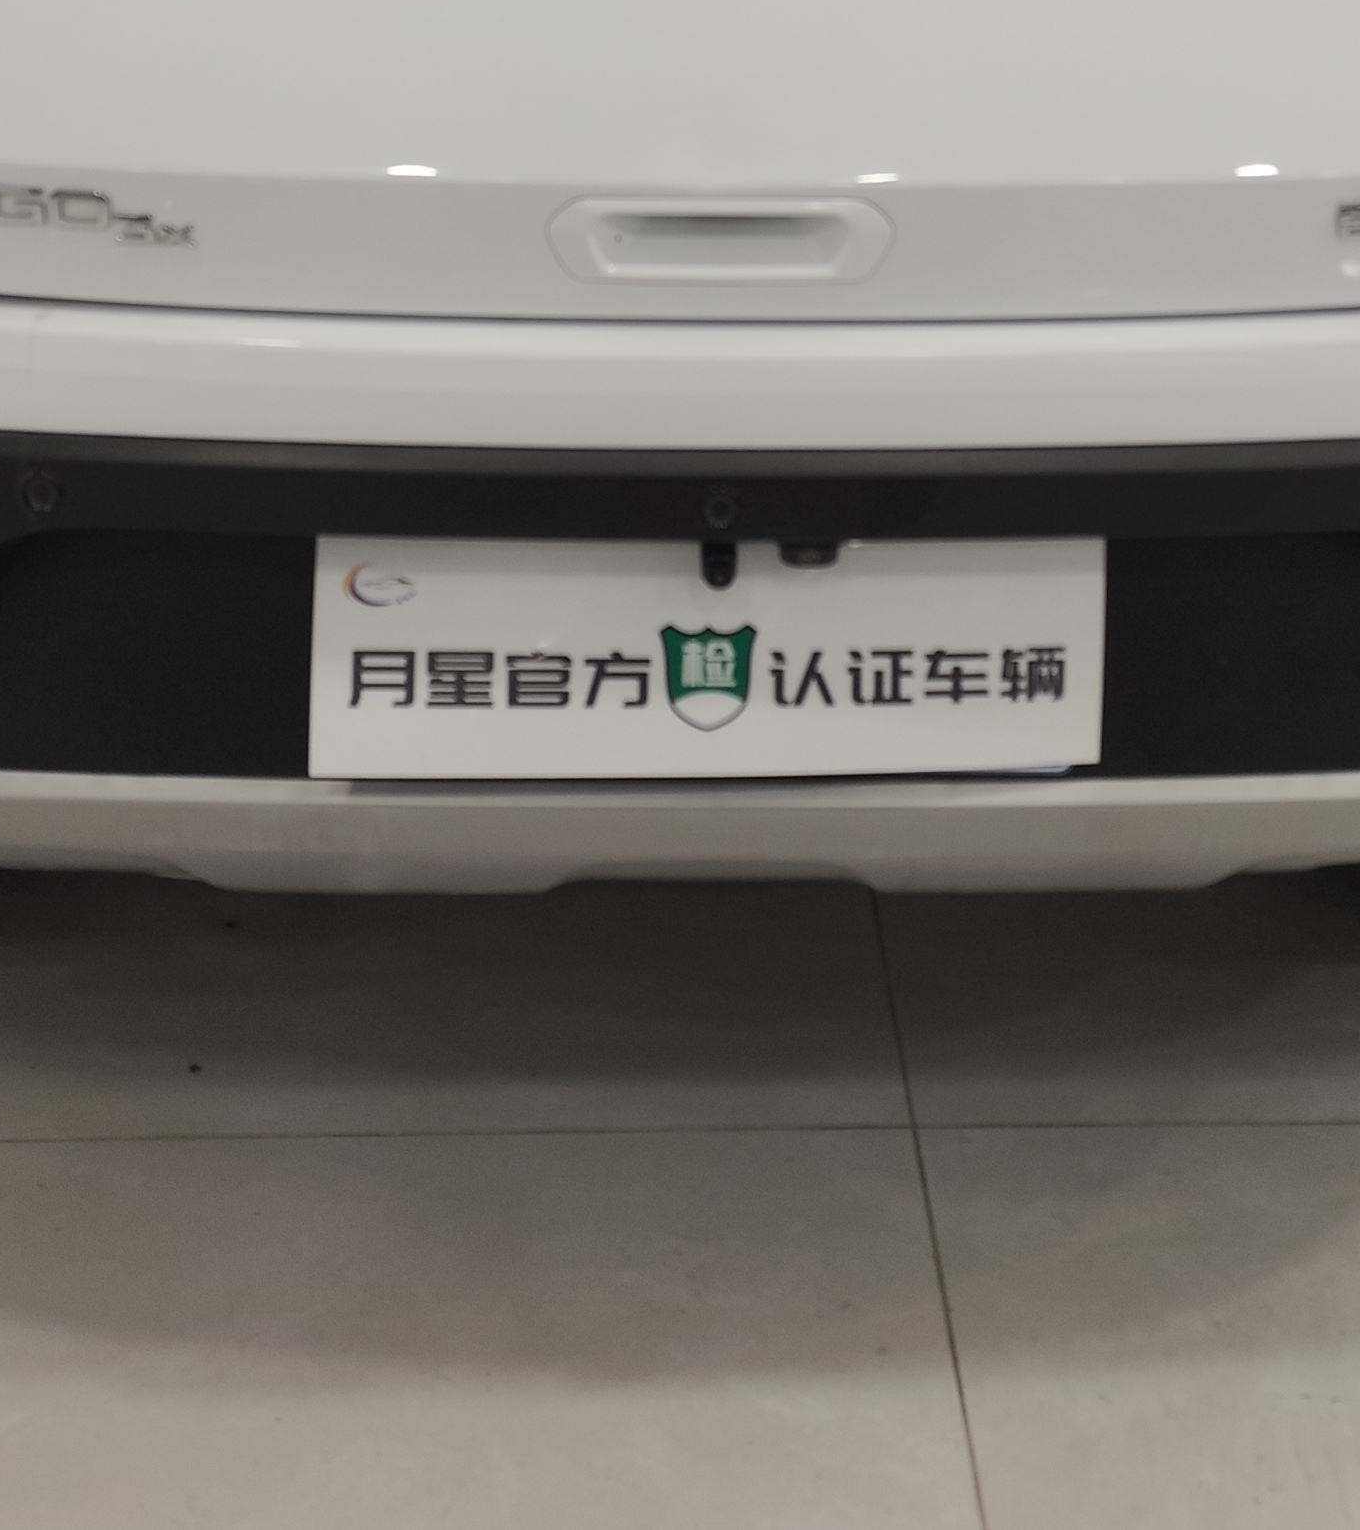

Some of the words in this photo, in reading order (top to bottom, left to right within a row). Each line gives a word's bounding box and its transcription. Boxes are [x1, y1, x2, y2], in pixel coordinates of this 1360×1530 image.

[348, 649, 652, 710] 月星官方
[770, 645, 1067, 709] 认证车辆
